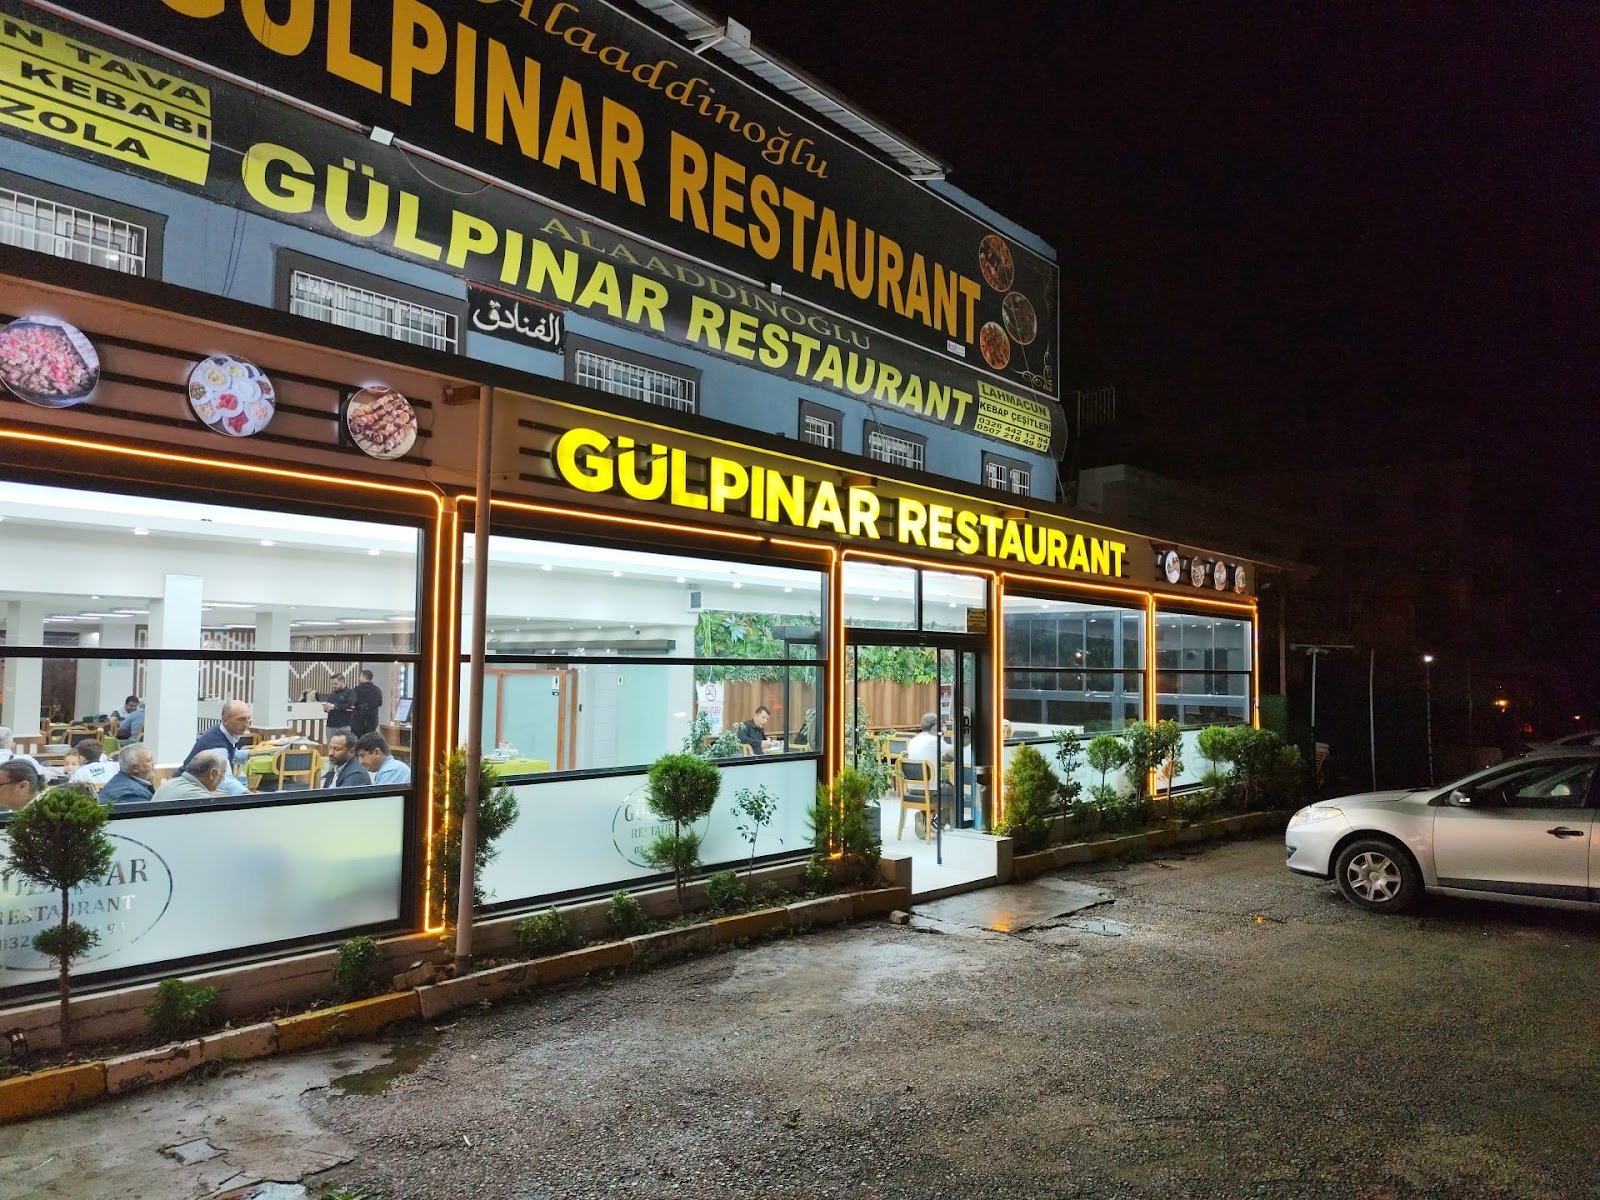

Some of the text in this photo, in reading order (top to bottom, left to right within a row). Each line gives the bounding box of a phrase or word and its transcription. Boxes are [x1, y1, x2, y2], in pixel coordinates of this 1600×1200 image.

[21, 60, 208, 140] KEBABI
[65, 42, 207, 107] TAVA
[669, 130, 981, 345] RESTAURANT
[242, 142, 972, 426] GÜLPINAR RESTAURANT
[540, 217, 870, 350] ALAADDİNOĞLU
[976, 423, 1000, 436] 0507
[978, 417, 1002, 430] 0326
[1004, 426, 1022, 436] 442
[1025, 432, 1035, 440] 13
[979, 400, 1051, 434] KEBAP ÇEŞİTLERİ
[981, 384, 1047, 417] LAHMACUN
[556, 427, 1127, 577] GÜLPINAR RESTAURANT
